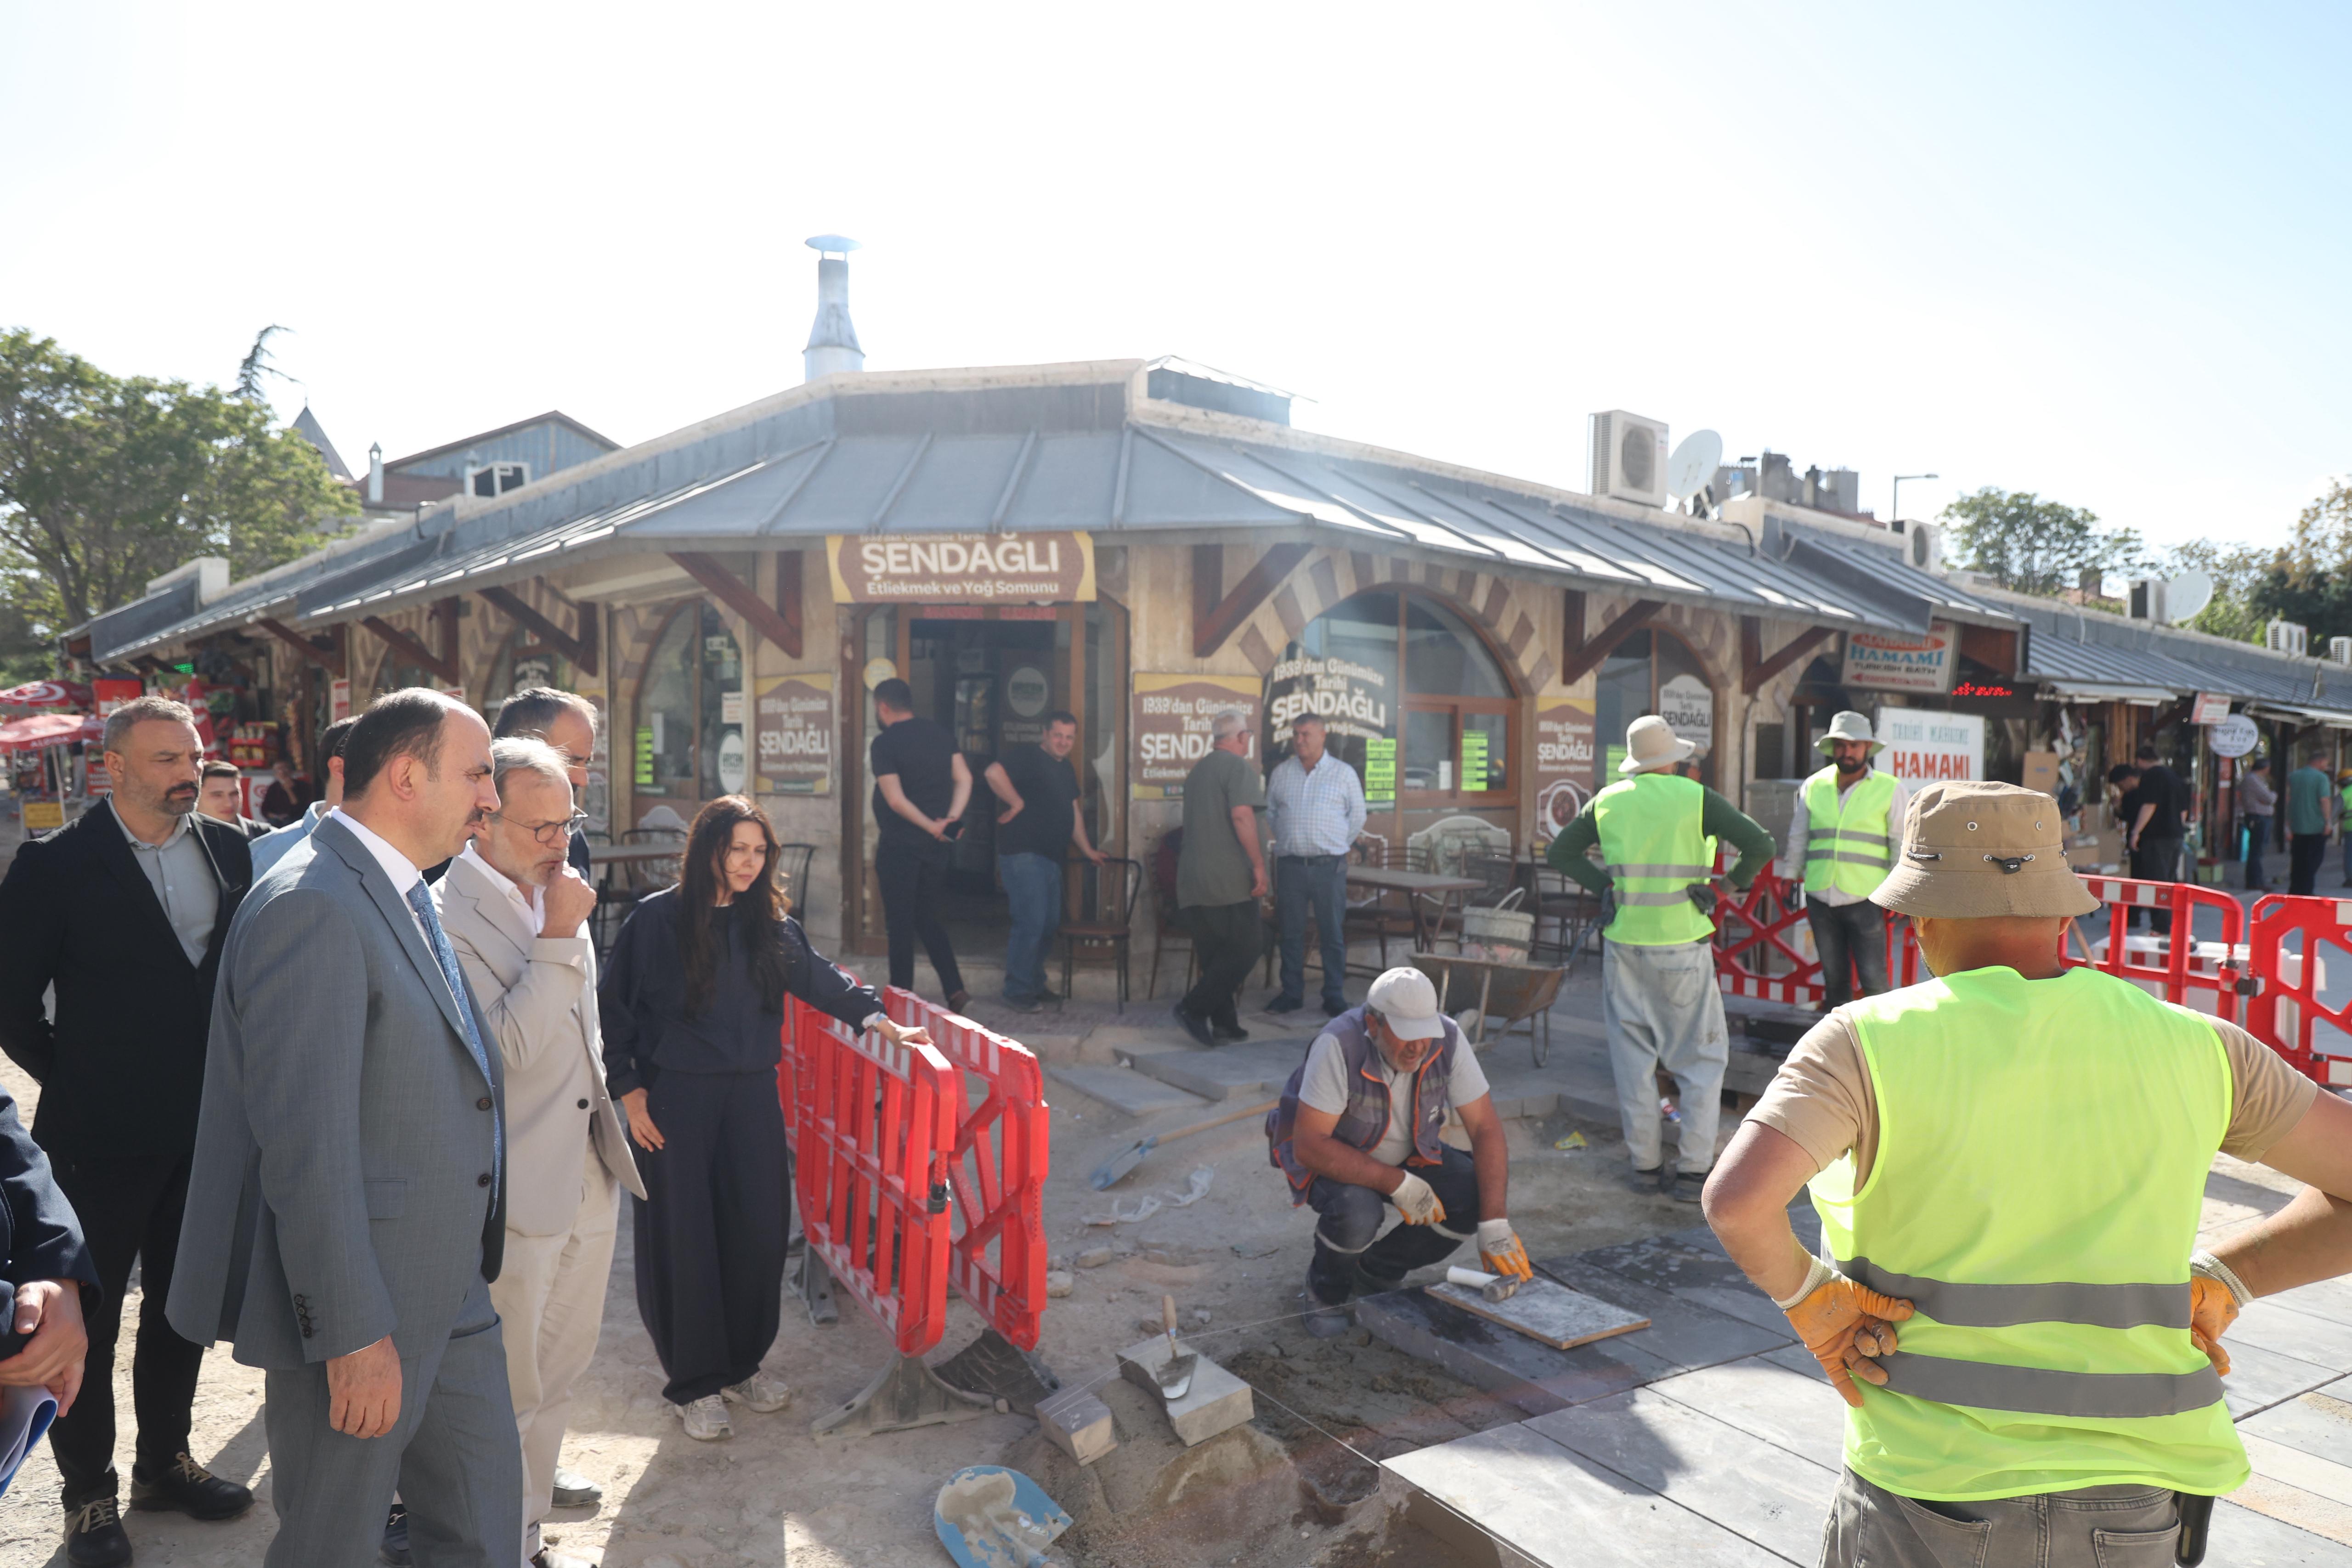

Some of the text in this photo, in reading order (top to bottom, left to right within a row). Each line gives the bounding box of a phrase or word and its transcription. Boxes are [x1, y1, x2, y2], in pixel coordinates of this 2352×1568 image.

[862, 532, 1059, 581] ŞENDAĞLI
[867, 581, 1059, 597] Etliekmek ve Yağ Somunu
[1850, 644, 1945, 666] HAMAMI
[1273, 657, 1385, 687] 1939'dan Günümüze
[1313, 673, 1348, 690] Tarihi
[1142, 696, 1193, 714] 1939'dan
[1270, 687, 1386, 729] ŞENDAĞLI
[1182, 716, 1213, 732] Tarih
[759, 722, 830, 760] ŞENDAĞLI
[1140, 732, 1255, 765] ŞENDAI
[1538, 739, 1594, 764] ŞENDAĞLI
[1893, 750, 1970, 780] HAMAMI
